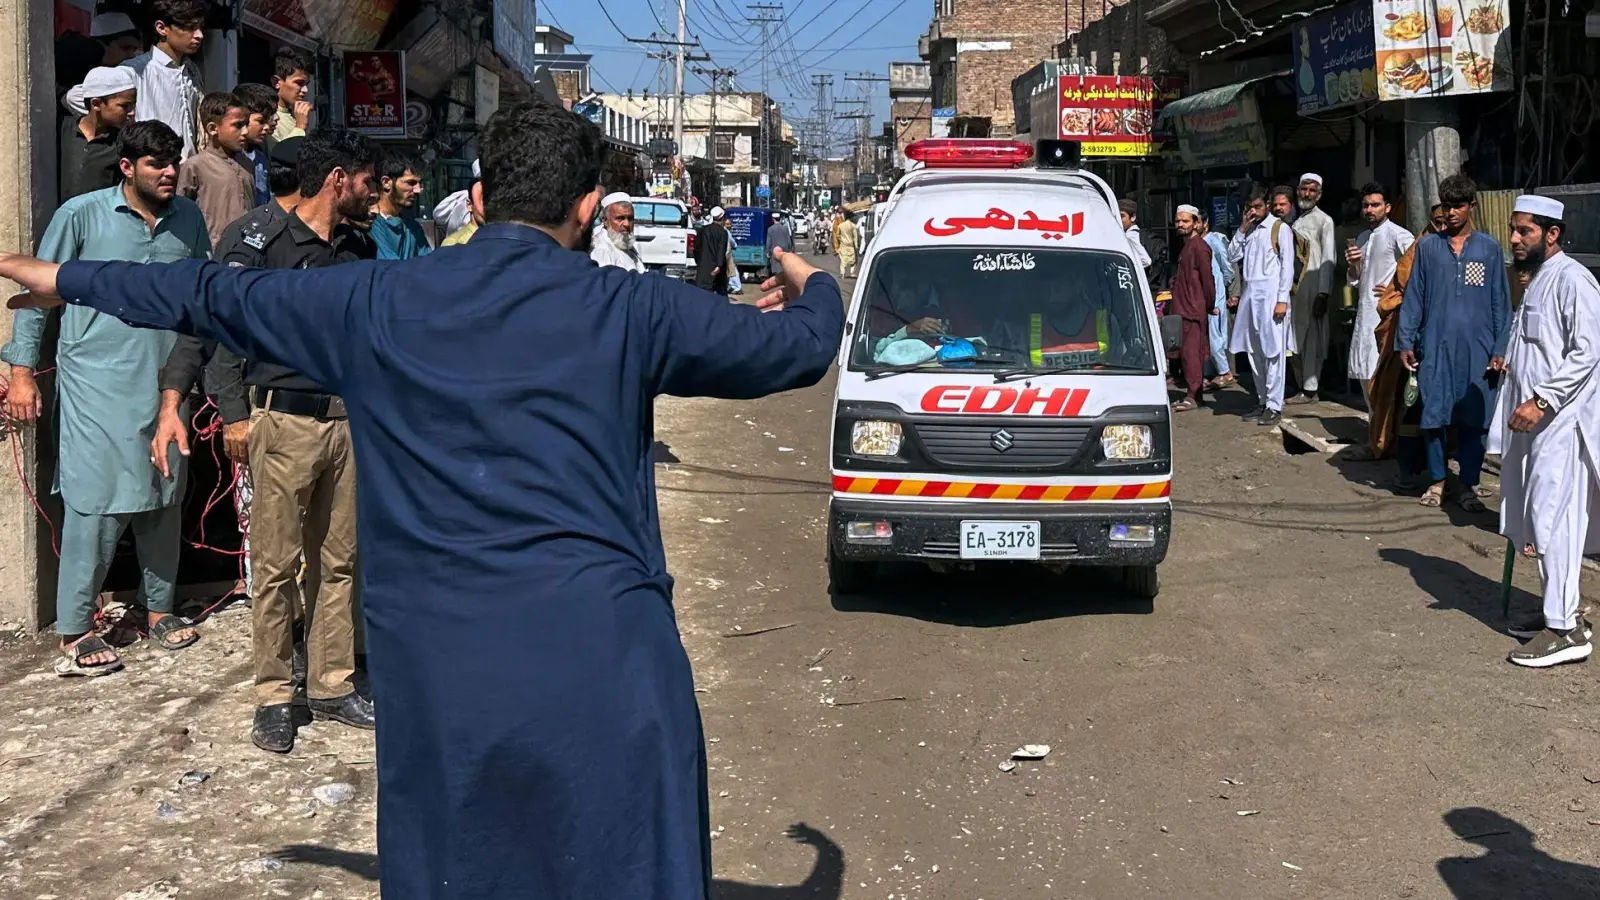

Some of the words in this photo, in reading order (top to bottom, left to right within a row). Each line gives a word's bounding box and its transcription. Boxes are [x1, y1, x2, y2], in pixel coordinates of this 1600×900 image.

[924, 207, 1084, 240] ایدھی
[1044, 353, 1096, 367] RESCUE
[920, 385, 1090, 416] EDHI
[966, 531, 1035, 548] EA-3178
